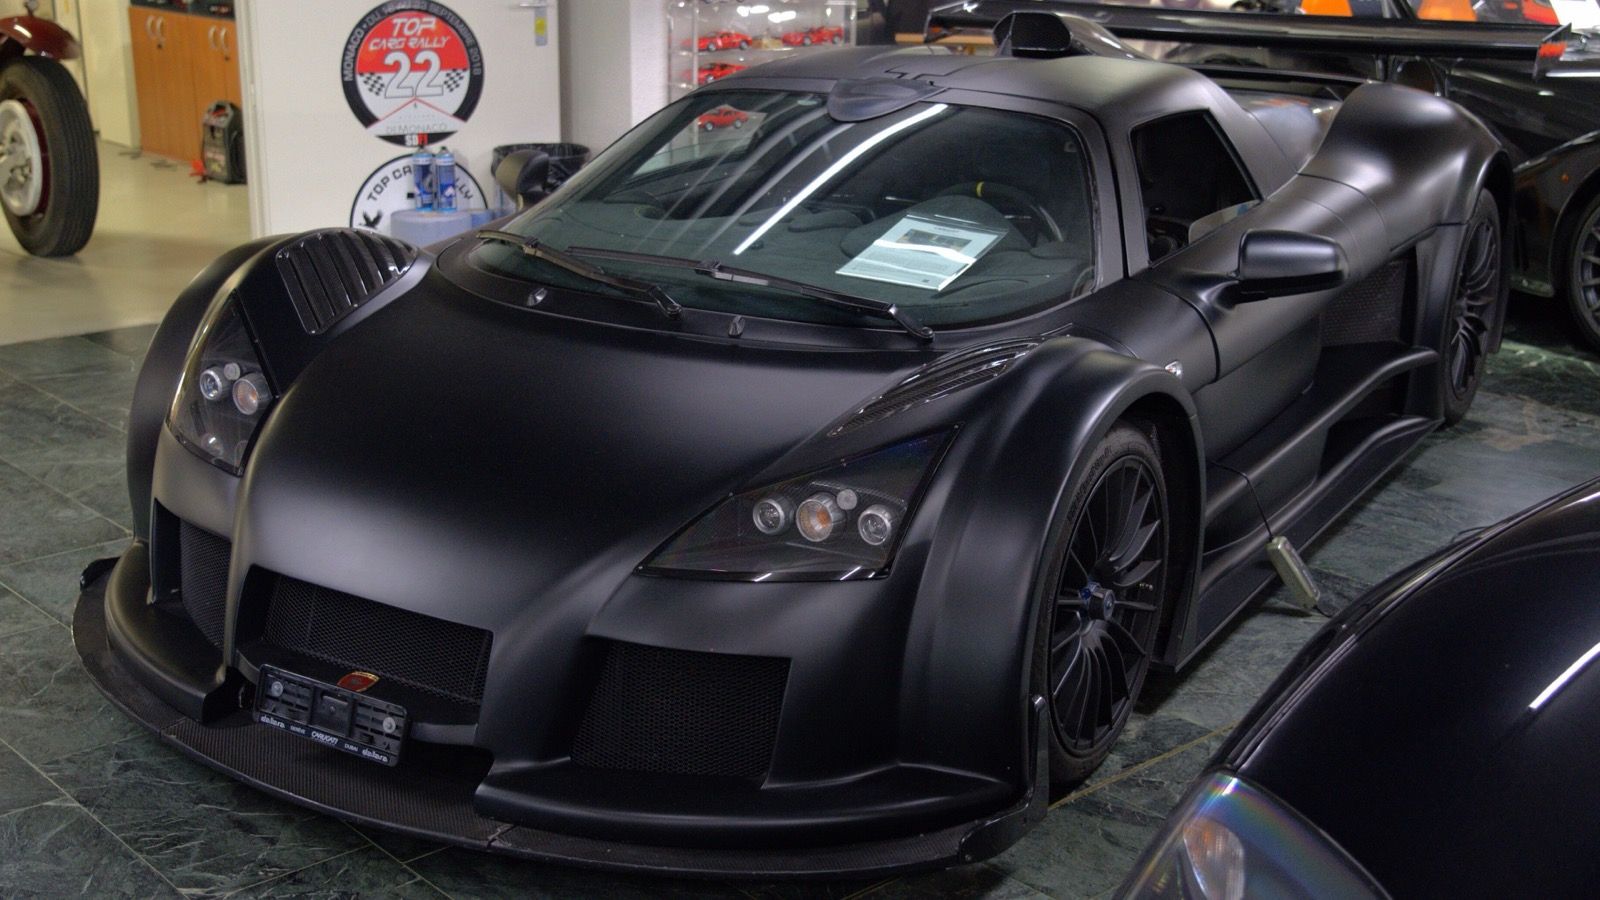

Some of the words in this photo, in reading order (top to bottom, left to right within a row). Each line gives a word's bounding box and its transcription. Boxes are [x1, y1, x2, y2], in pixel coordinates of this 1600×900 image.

[391, 16, 437, 37] TOP
[343, 26, 365, 81] MONACO
[428, 1, 476, 46] SEPTEMBRE
[408, 35, 449, 49] RALLY
[383, 51, 444, 99] 22
[367, 176, 390, 201] TOP
[311, 731, 338, 744] CARUGATI
